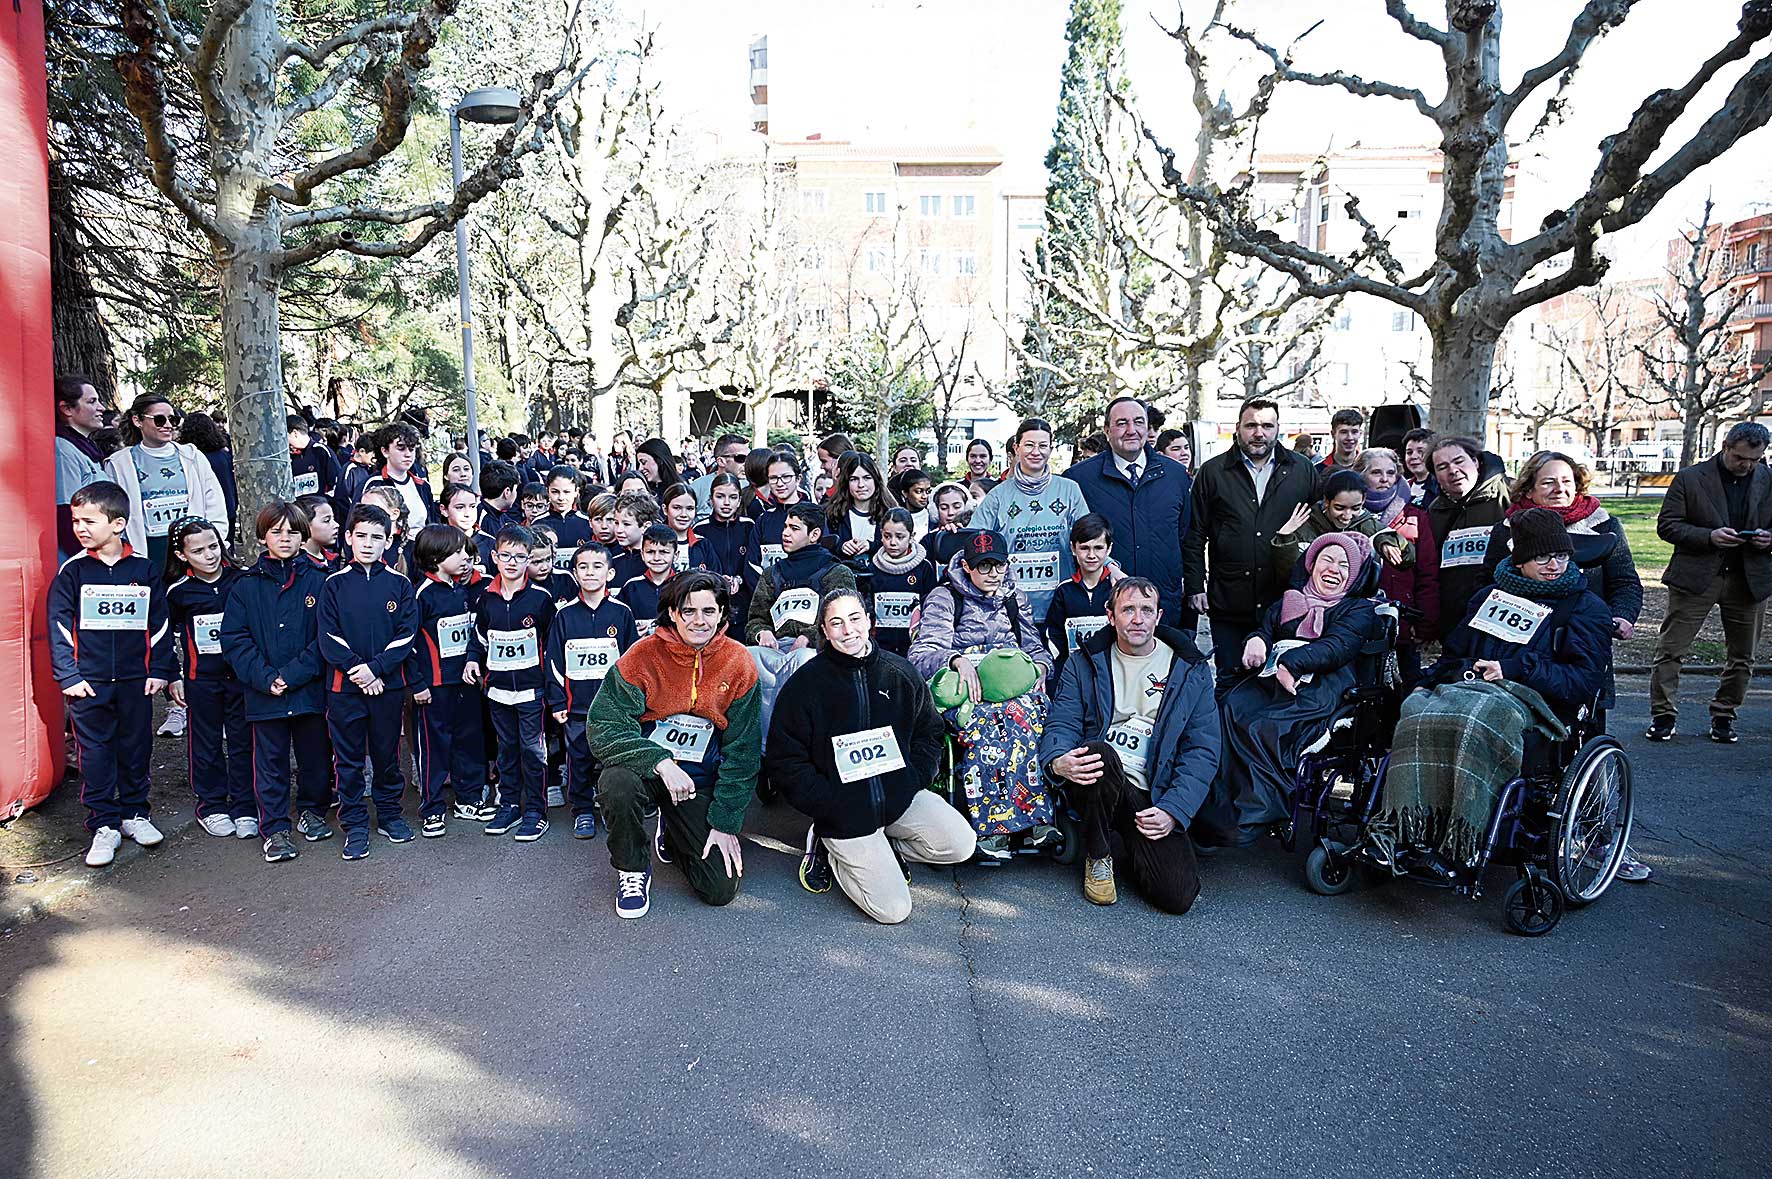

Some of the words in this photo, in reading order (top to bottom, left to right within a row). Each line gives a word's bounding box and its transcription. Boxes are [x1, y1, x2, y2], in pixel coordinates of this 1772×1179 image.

[1448, 540, 1486, 555] 1186
[1017, 566, 1054, 579] 1178
[98, 601, 137, 615] 884
[775, 600, 811, 615] 1179
[884, 605, 909, 616] 750
[1488, 605, 1533, 631] 1183
[497, 644, 526, 658] 781
[578, 653, 608, 666] 788
[666, 728, 698, 747] 001
[849, 744, 886, 764] 002
